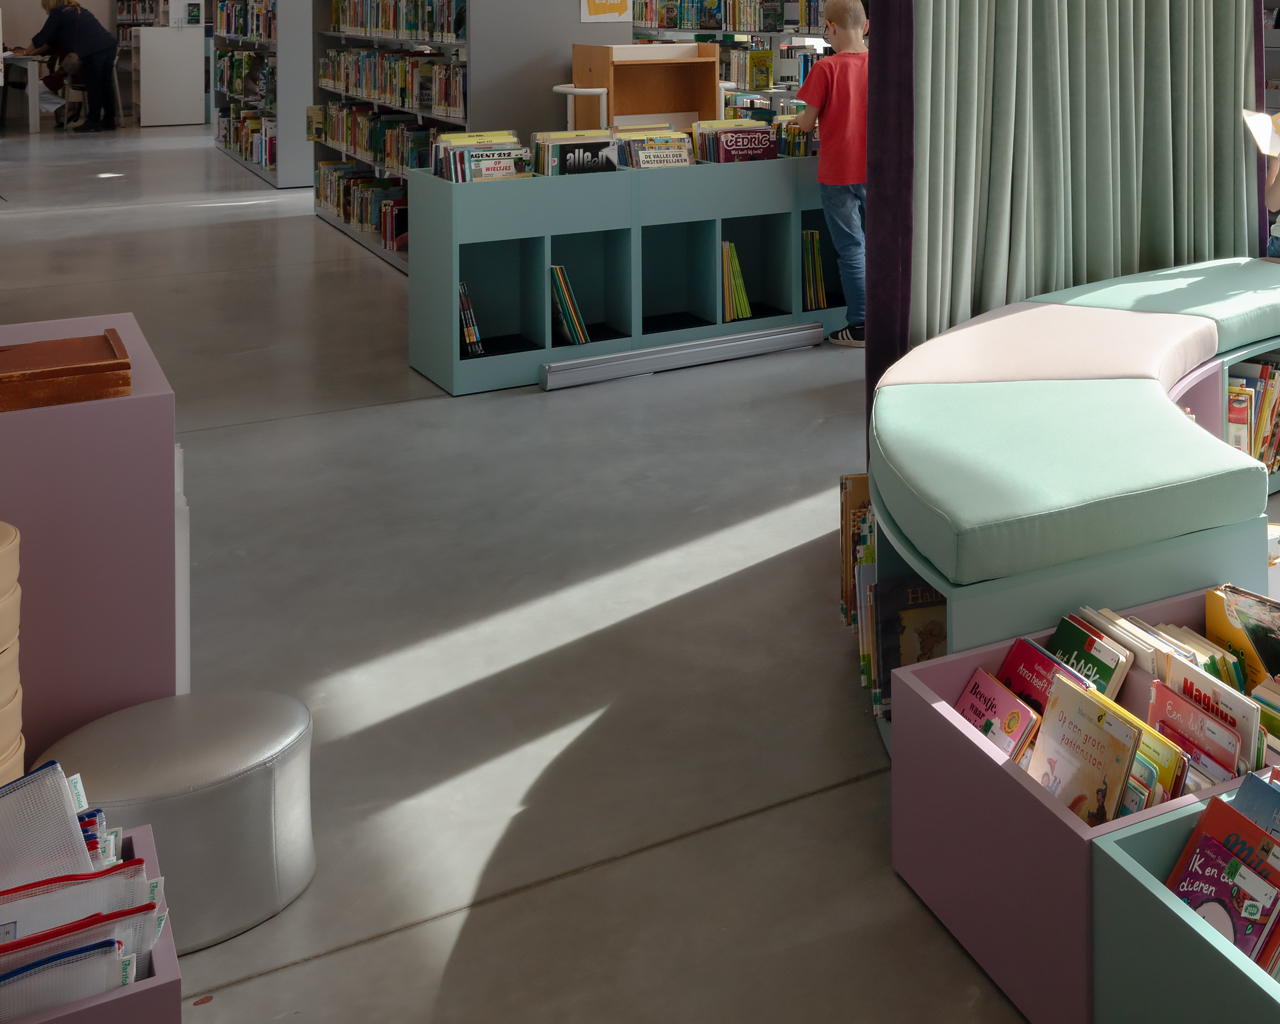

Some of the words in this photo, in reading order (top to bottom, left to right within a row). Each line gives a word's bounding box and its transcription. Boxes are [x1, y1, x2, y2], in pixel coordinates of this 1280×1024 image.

[1017, 662, 1031, 681] Anna
[1030, 671, 1049, 692] heeft
[1068, 650, 1100, 683] boek
[969, 681, 997, 716] Beestje,
[968, 702, 986, 721] waar
[1165, 700, 1184, 724] Een
[1058, 710, 1067, 728] Op
[1067, 720, 1082, 737] een
[1082, 733, 1106, 754] grote
[1204, 866, 1218, 879] en
[1179, 877, 1216, 897] dieren
[1246, 904, 1259, 915] 2020
